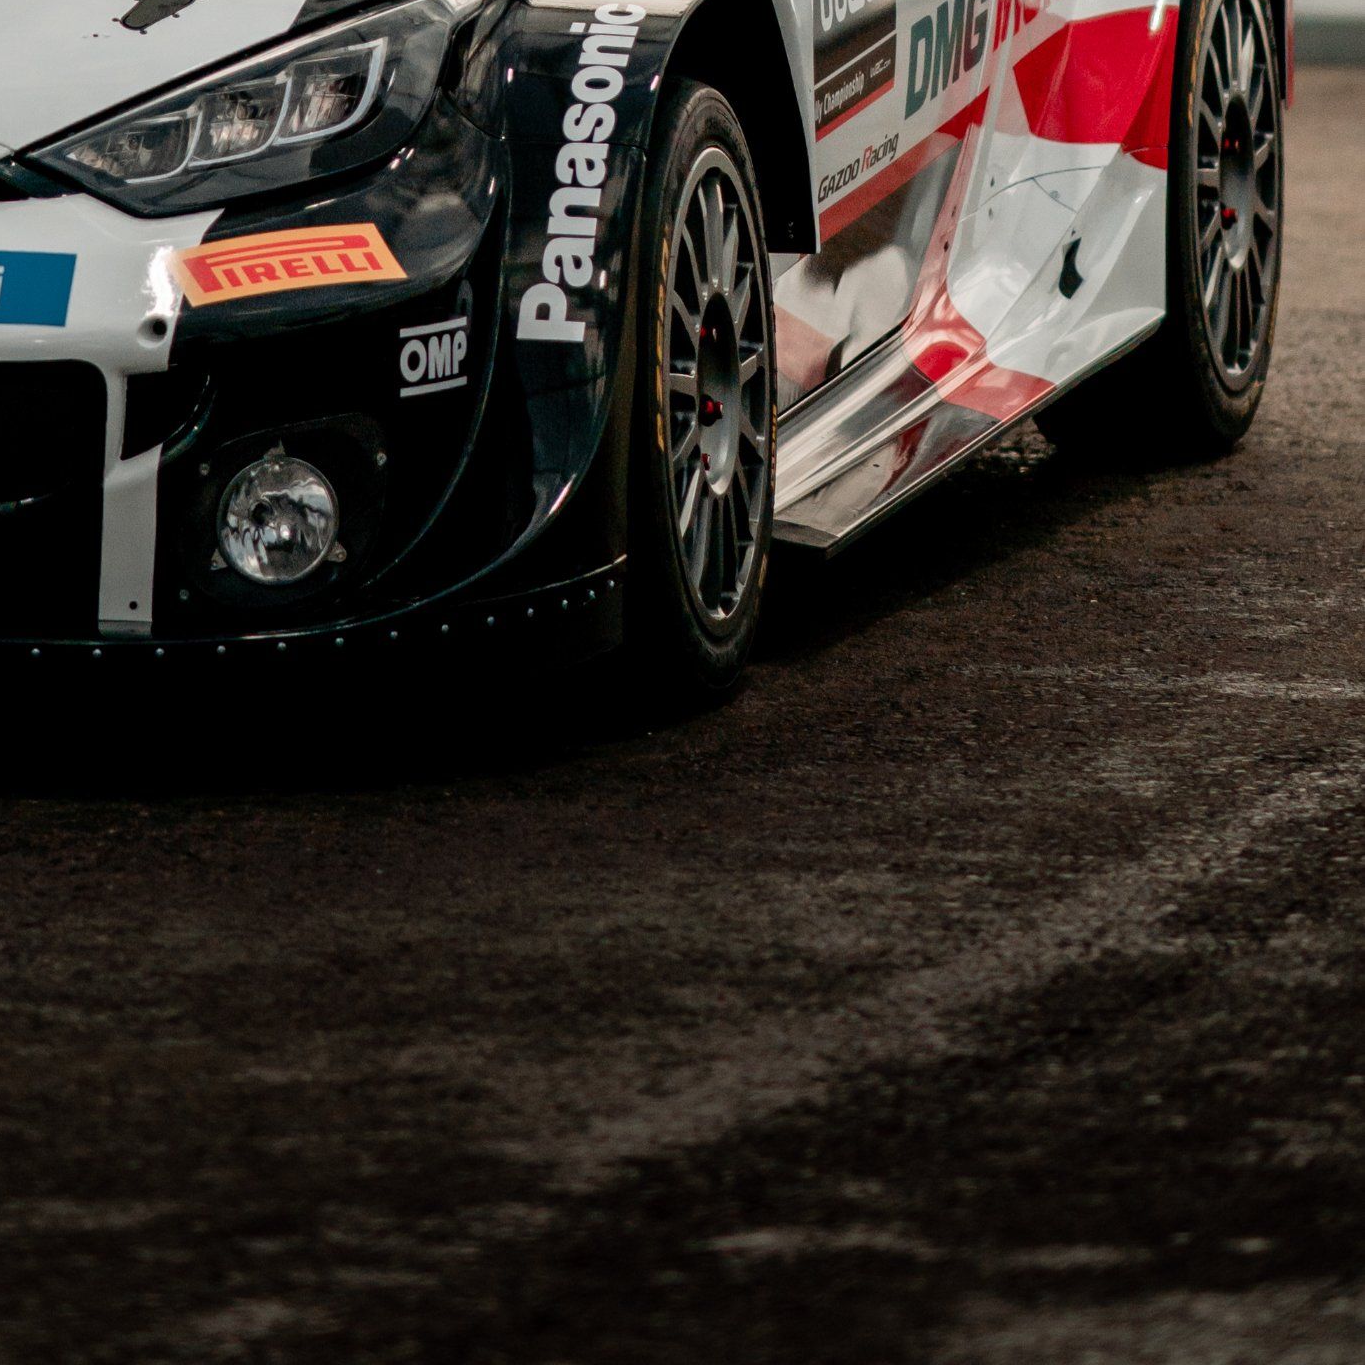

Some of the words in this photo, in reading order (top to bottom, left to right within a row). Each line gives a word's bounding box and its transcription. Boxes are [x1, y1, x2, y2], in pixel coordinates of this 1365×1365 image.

[515, 2, 647, 343] Panasonic
[817, 157, 861, 204] GAZOO
[860, 132, 900, 174] Racing
[184, 234, 385, 294] PIRELLI
[399, 329, 467, 383] OMP
